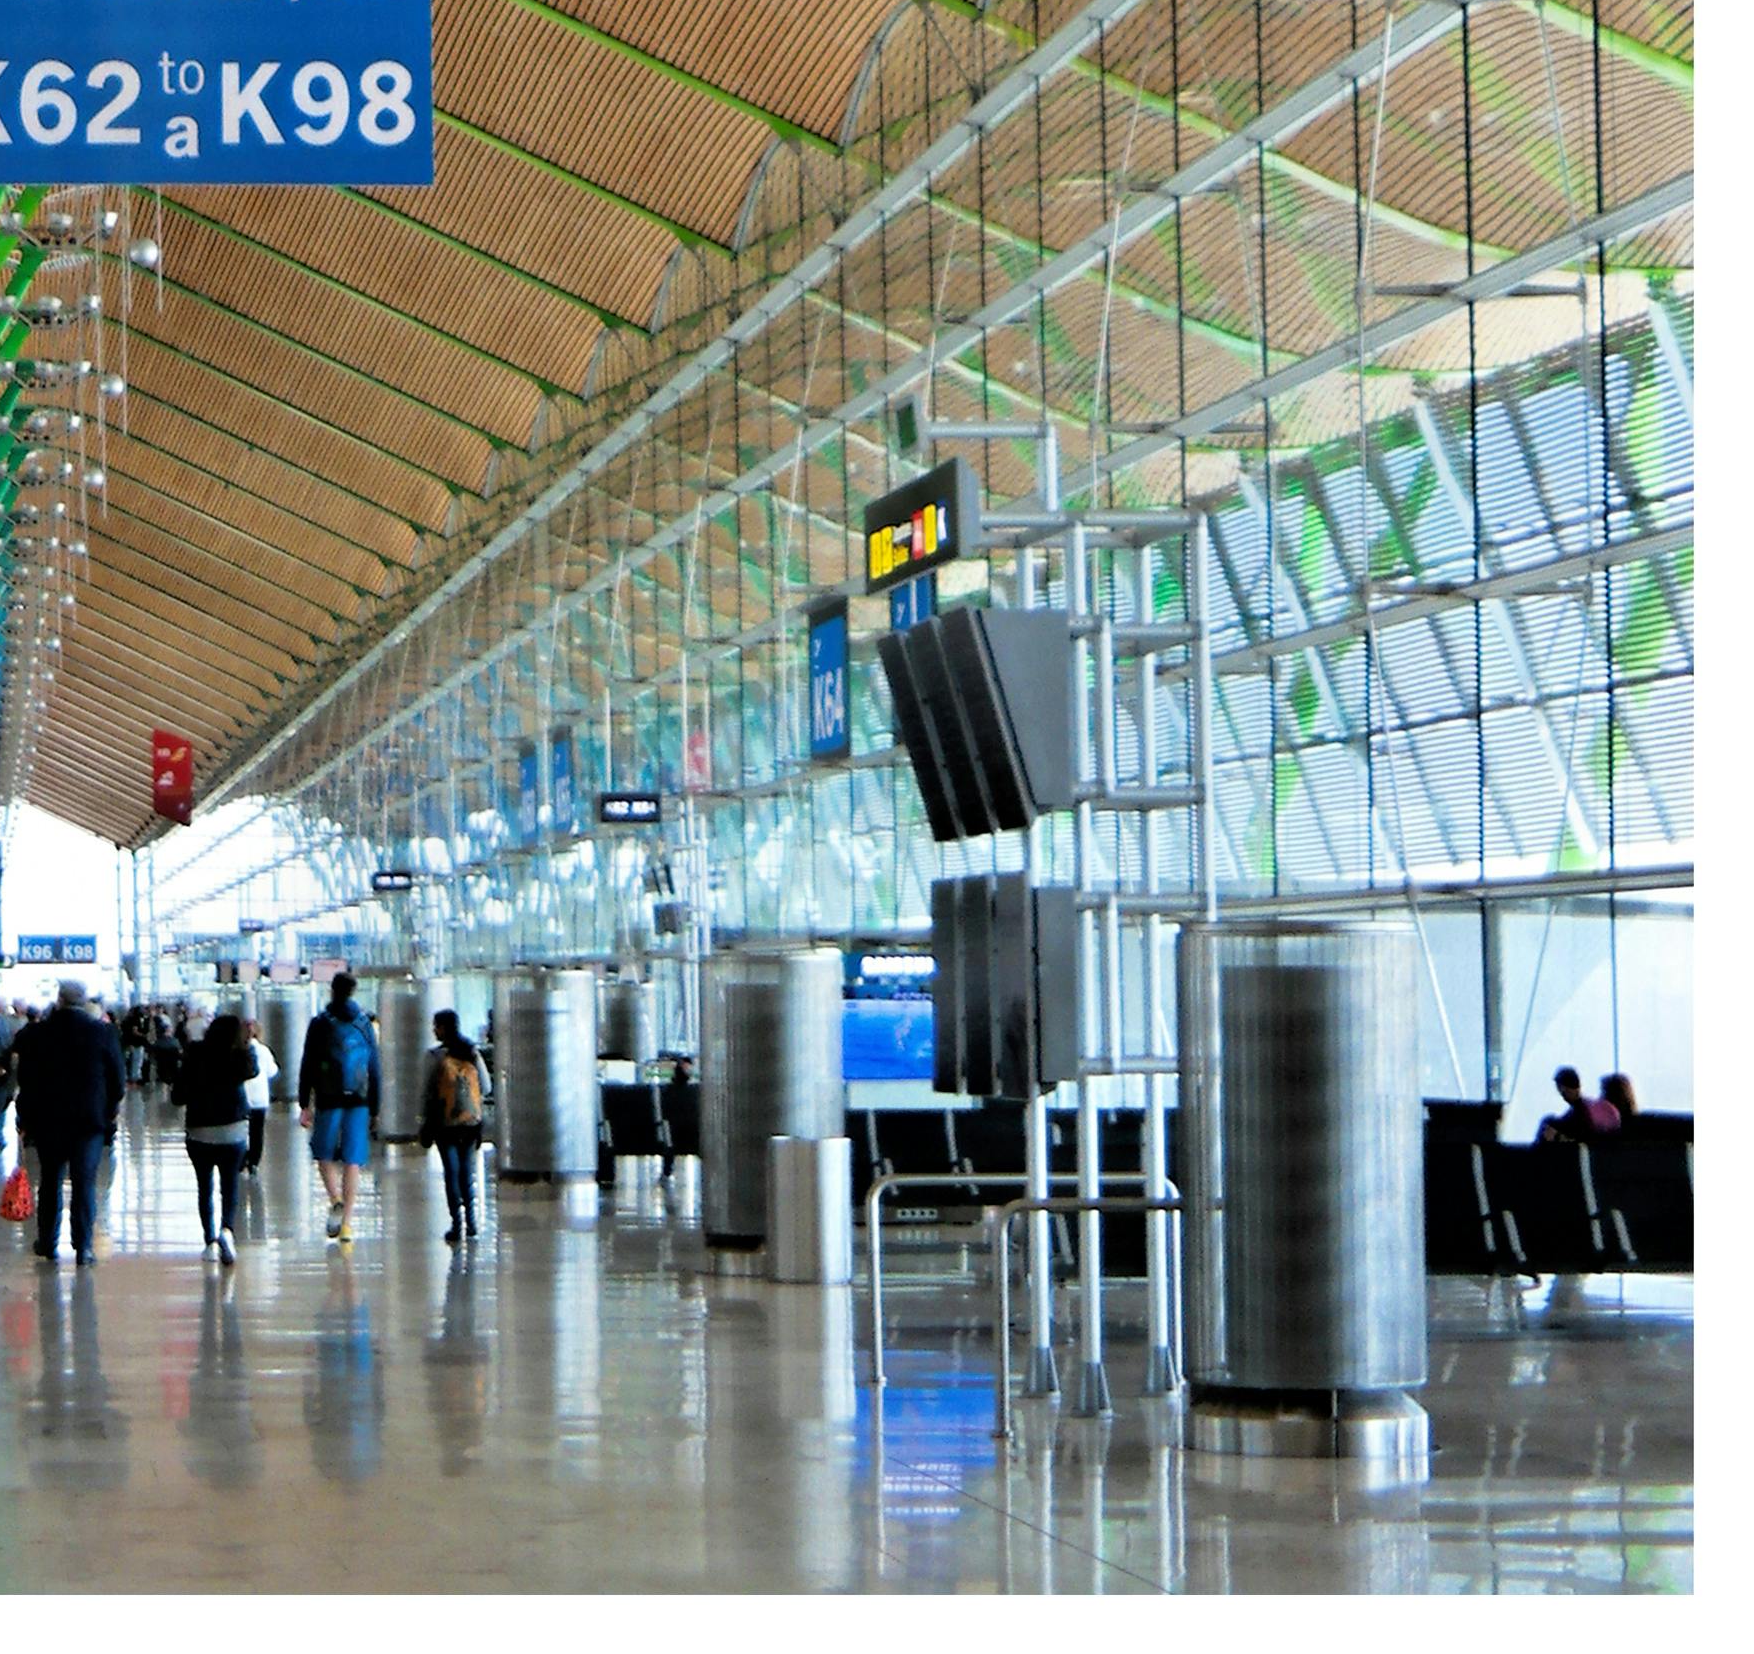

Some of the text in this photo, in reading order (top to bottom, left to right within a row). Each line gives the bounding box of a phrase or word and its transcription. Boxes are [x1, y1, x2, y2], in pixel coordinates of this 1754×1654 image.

[159, 51, 205, 95] to
[222, 60, 415, 147] K98
[165, 116, 200, 159] a
[813, 666, 844, 741] K64
[22, 945, 94, 960] K96 K98
